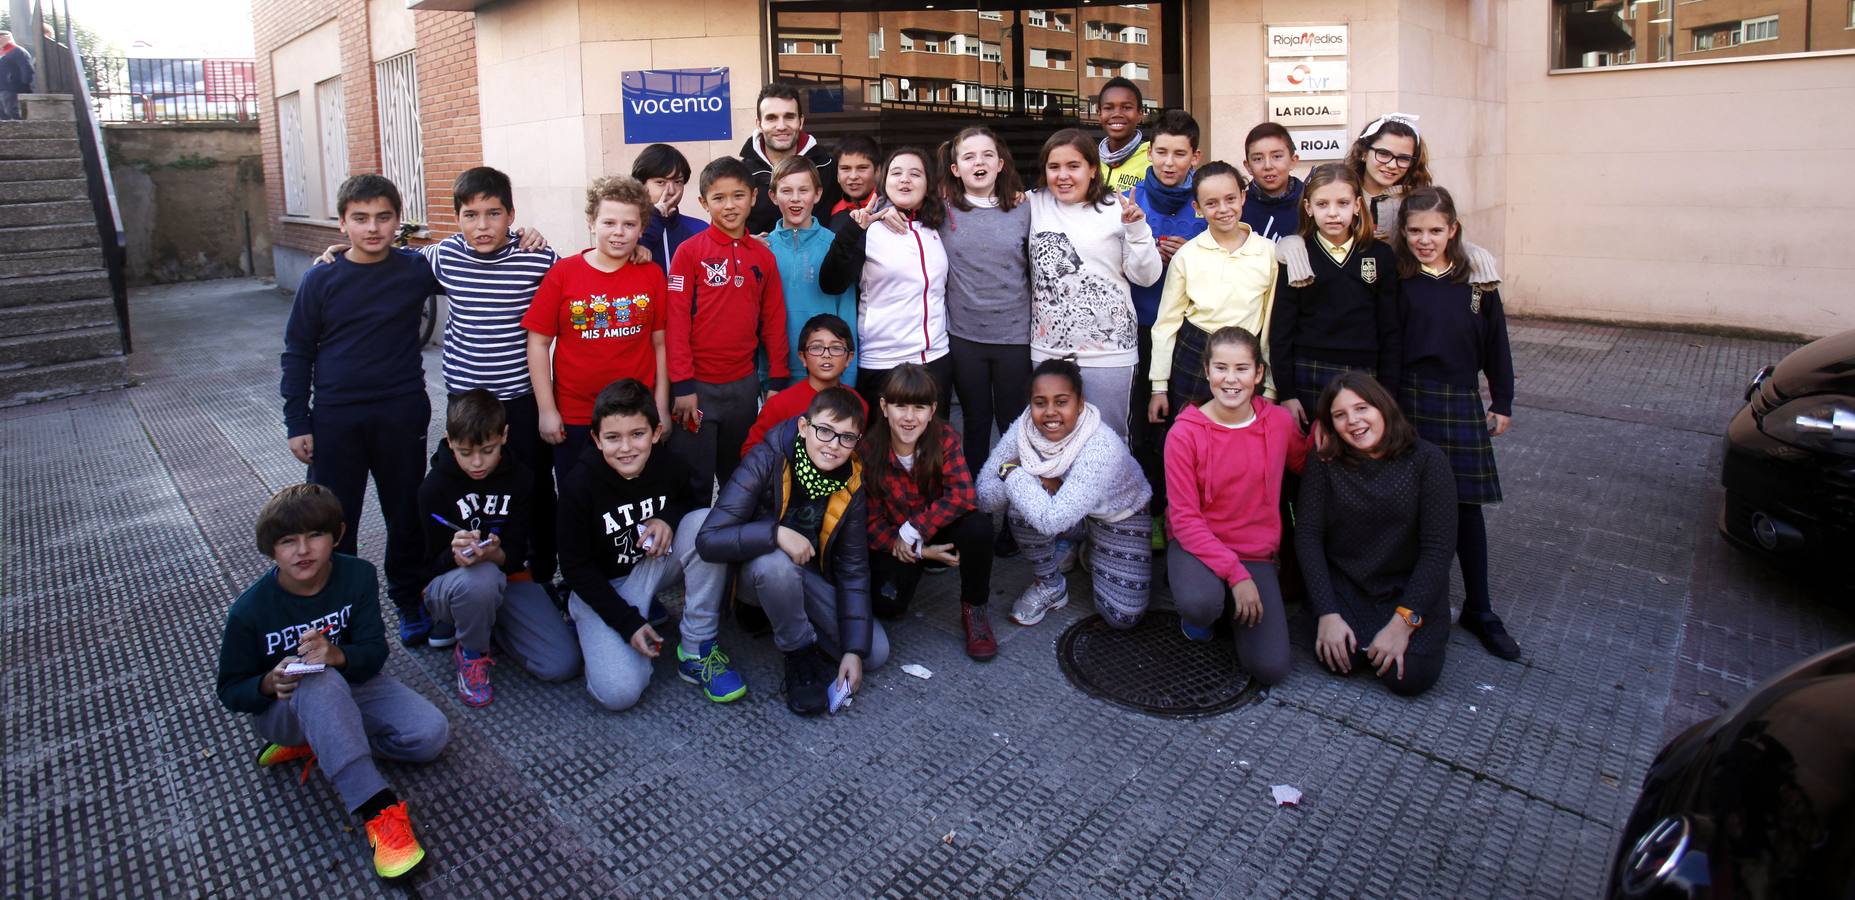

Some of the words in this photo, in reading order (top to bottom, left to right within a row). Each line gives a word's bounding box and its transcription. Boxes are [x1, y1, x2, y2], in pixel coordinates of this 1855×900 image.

[1273, 32, 1343, 47] RiojaMedios
[1308, 76, 1330, 89] tvr
[631, 96, 723, 115] vocento
[1275, 107, 1291, 117] LA
[1293, 106, 1330, 116] RIOJA
[1300, 140, 1340, 151] RIOJA
[581, 329, 600, 339] MIS
[603, 324, 643, 338] AMIGOS
